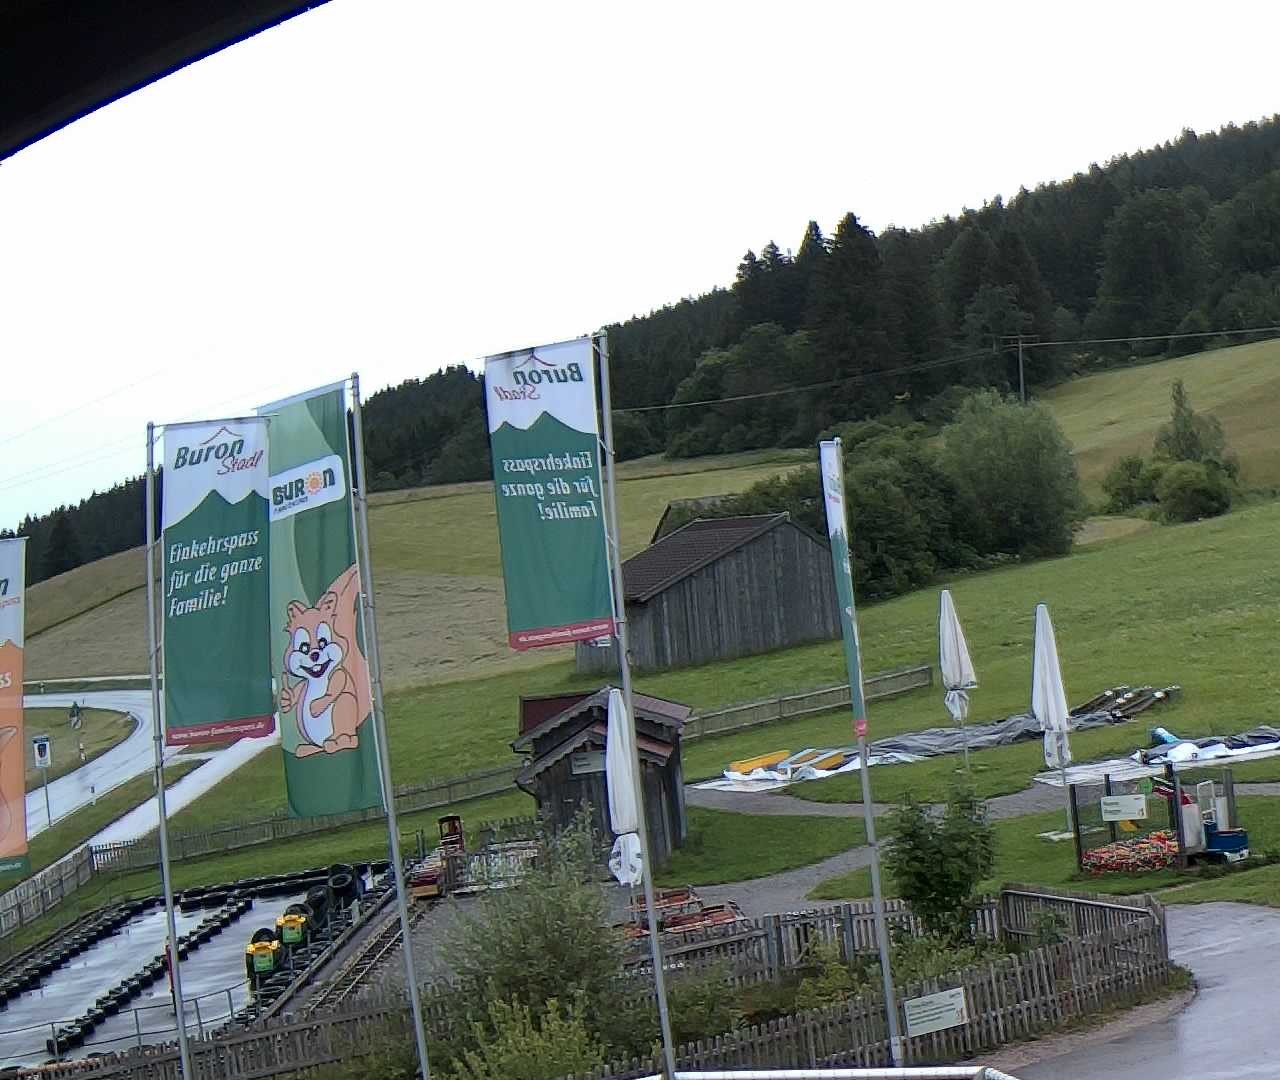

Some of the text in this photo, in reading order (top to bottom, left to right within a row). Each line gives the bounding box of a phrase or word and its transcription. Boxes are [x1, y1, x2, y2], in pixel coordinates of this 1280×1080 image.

[173, 439, 245, 470] Buron
[217, 450, 264, 476] Stadl
[169, 530, 260, 564] Einkehrspass
[167, 555, 263, 597] für die ganze
[168, 586, 229, 618] Familie!
